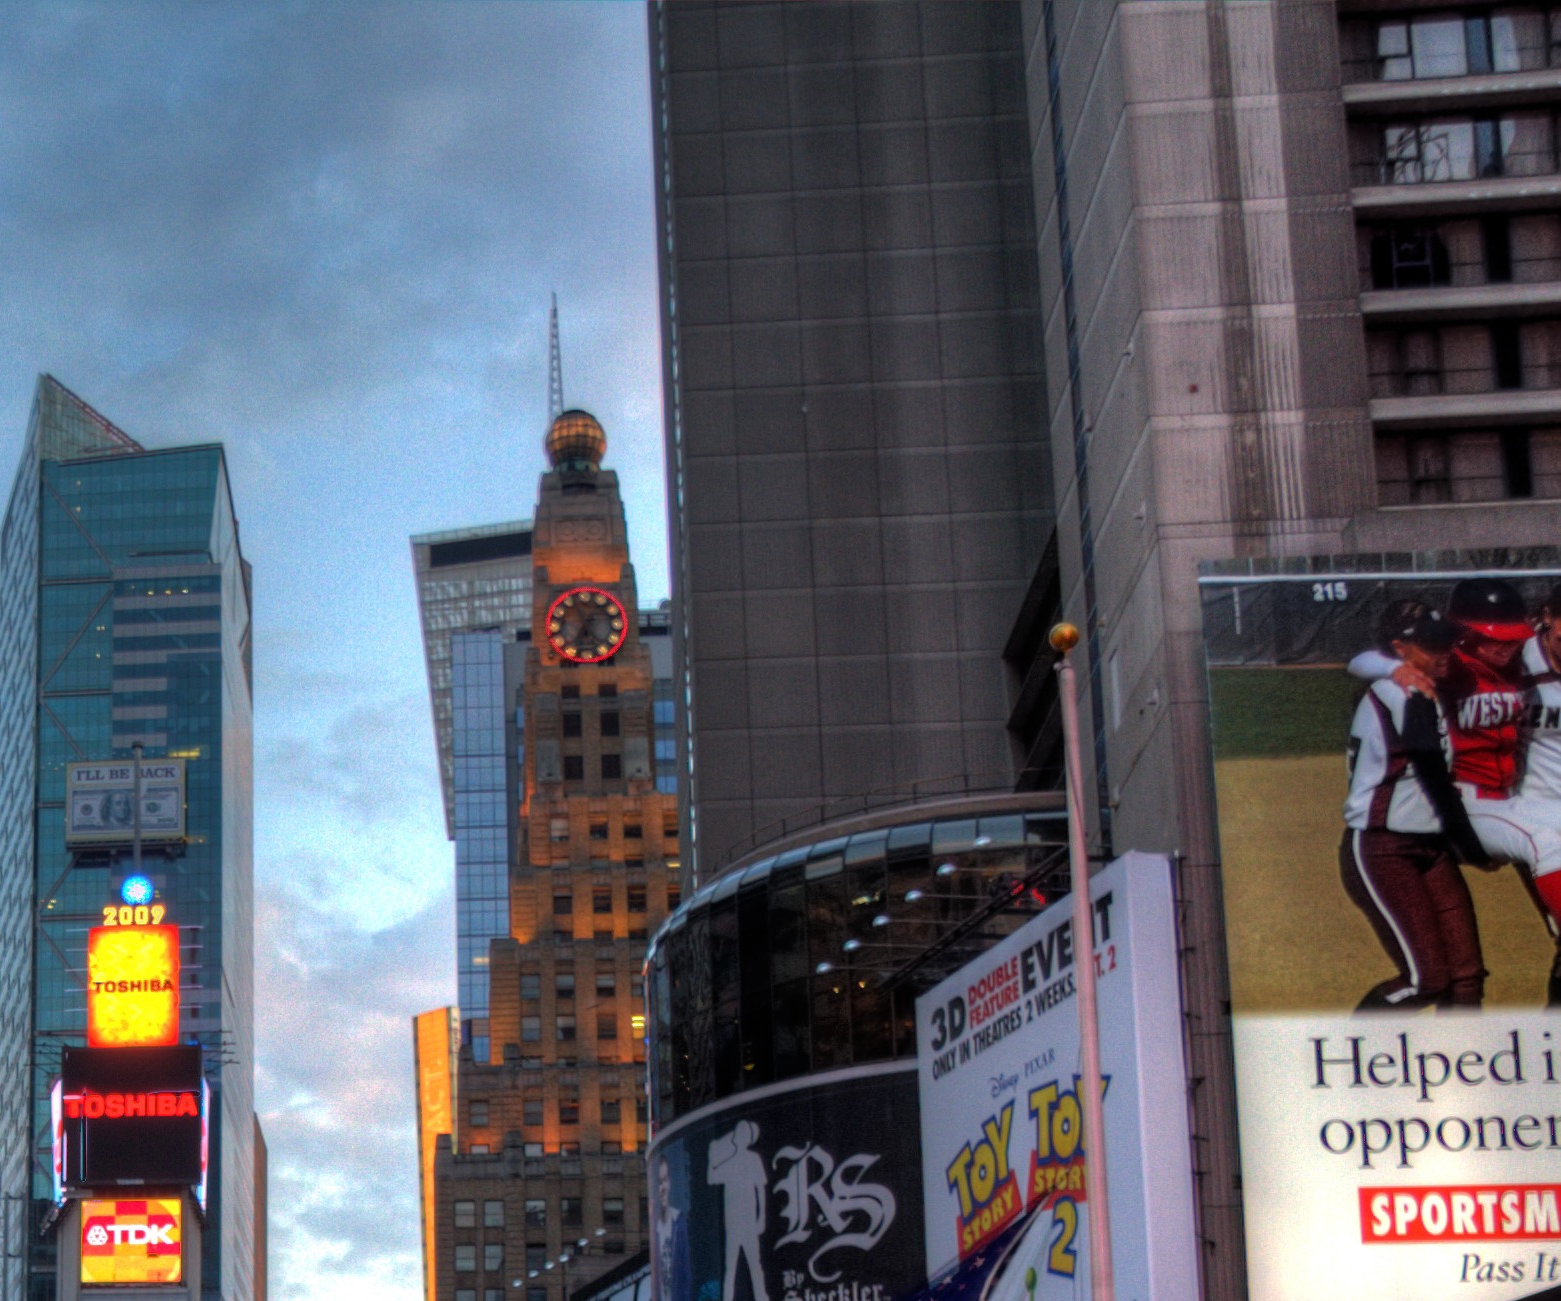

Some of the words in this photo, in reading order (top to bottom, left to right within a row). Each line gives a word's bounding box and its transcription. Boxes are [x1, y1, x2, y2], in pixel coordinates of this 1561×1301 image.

[1312, 582, 1348, 600] 215
[76, 767, 105, 781] I'LL
[109, 768, 130, 780] BE
[103, 904, 165, 927] 2009
[92, 979, 175, 994] TOSHIBA
[967, 955, 1019, 1005] DOUBLE
[930, 995, 966, 1053] 3D
[932, 1050, 957, 1081] ONLY
[960, 1043, 971, 1064] IN
[973, 1012, 1022, 1054] THEATRES
[1025, 1001, 1034, 1024] 2
[1108, 945, 1118, 971] 2
[968, 984, 1021, 1031] FEATURE
[1024, 1047, 1056, 1081] PIXAR
[1309, 1028, 1527, 1103] Helped
[1543, 1031, 1561, 1084] i
[63, 1091, 199, 1120] TOSHIBA
[946, 1098, 1017, 1225] TOY
[107, 1223, 175, 1246] TDK
[961, 1193, 1015, 1254] STORY
[1370, 1189, 1561, 1237] SPORTSM
[1047, 1198, 1079, 1279] 2
[1459, 1253, 1526, 1284] Pass
[1534, 1252, 1559, 1282] It
